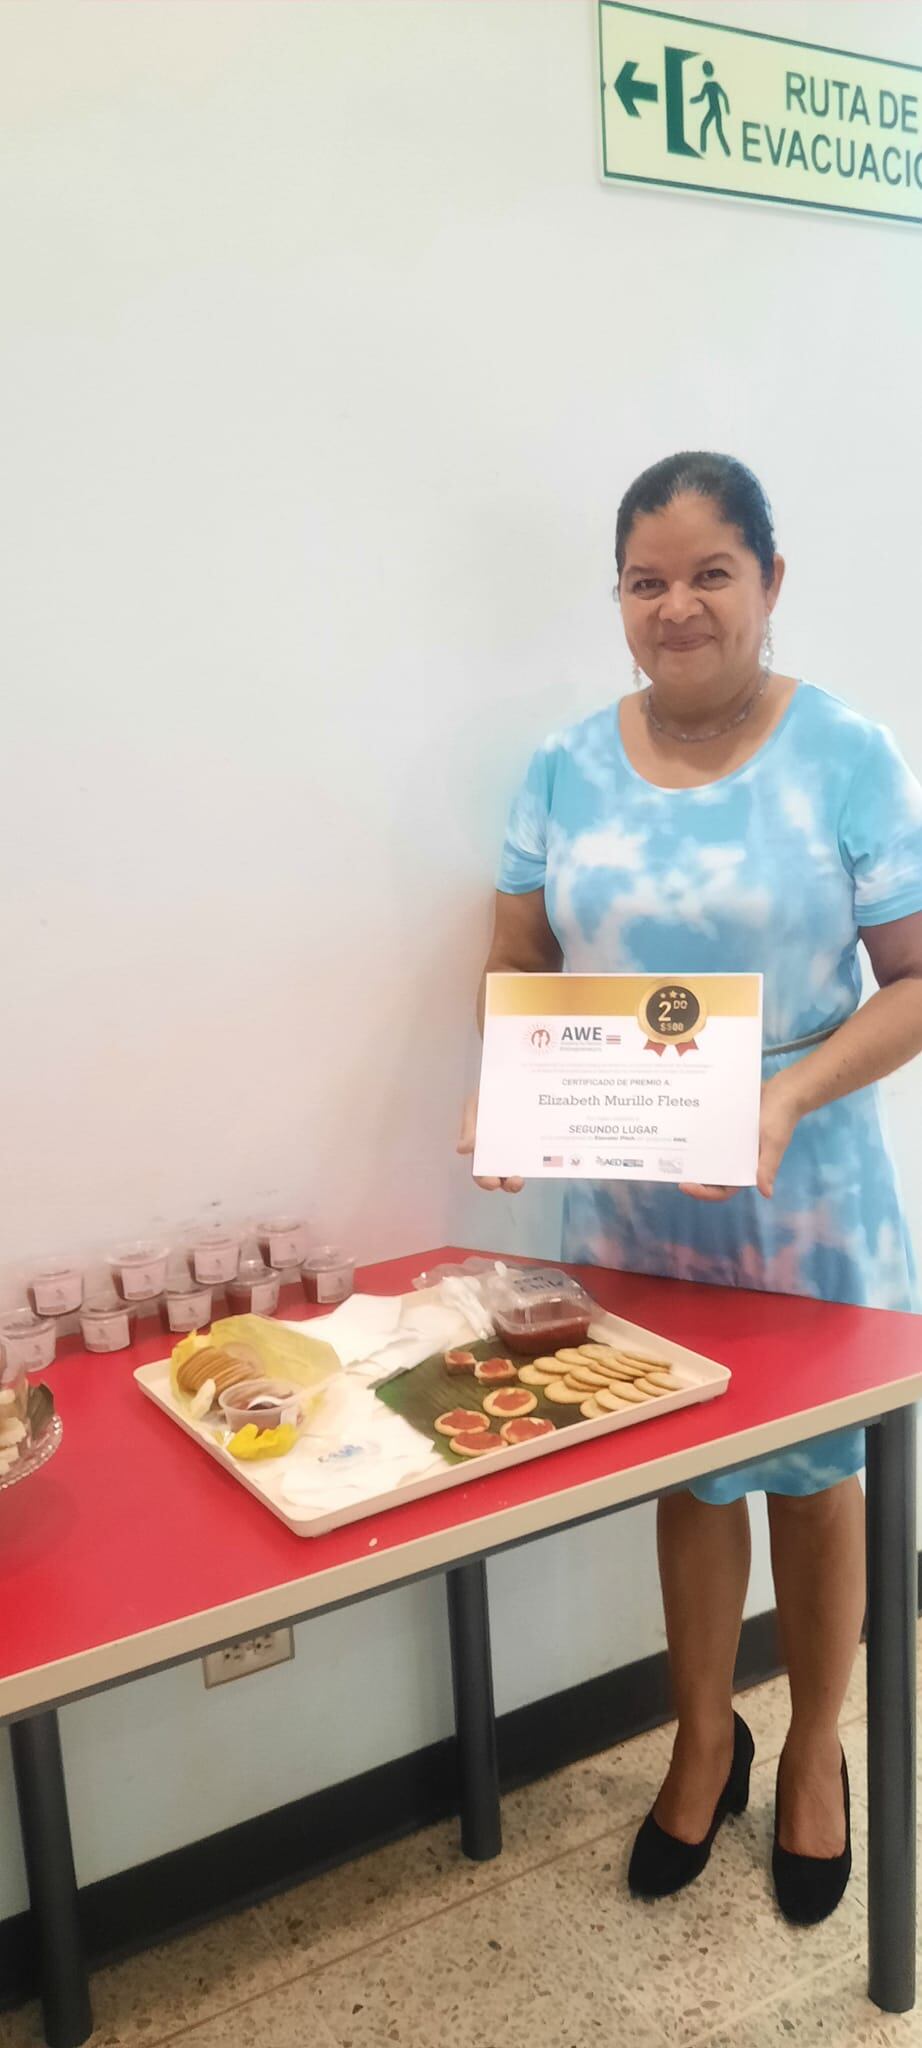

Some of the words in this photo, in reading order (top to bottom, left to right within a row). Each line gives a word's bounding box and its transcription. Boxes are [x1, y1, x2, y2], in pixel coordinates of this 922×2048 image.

[786, 71, 870, 125] RUTA
[879, 90, 918, 134] DE
[561, 1027, 603, 1041] AWE
[562, 1079, 615, 1087] CERTIFICADO
[617, 1079, 629, 1087] DE
[630, 1079, 662, 1087] PREMIO
[538, 1094, 601, 1107] Elizabeth
[604, 1095, 654, 1107] Murillo
[657, 1096, 700, 1108] Fletes
[569, 1125, 620, 1134] SEGUNDO
[622, 1125, 658, 1135] LUGAR
